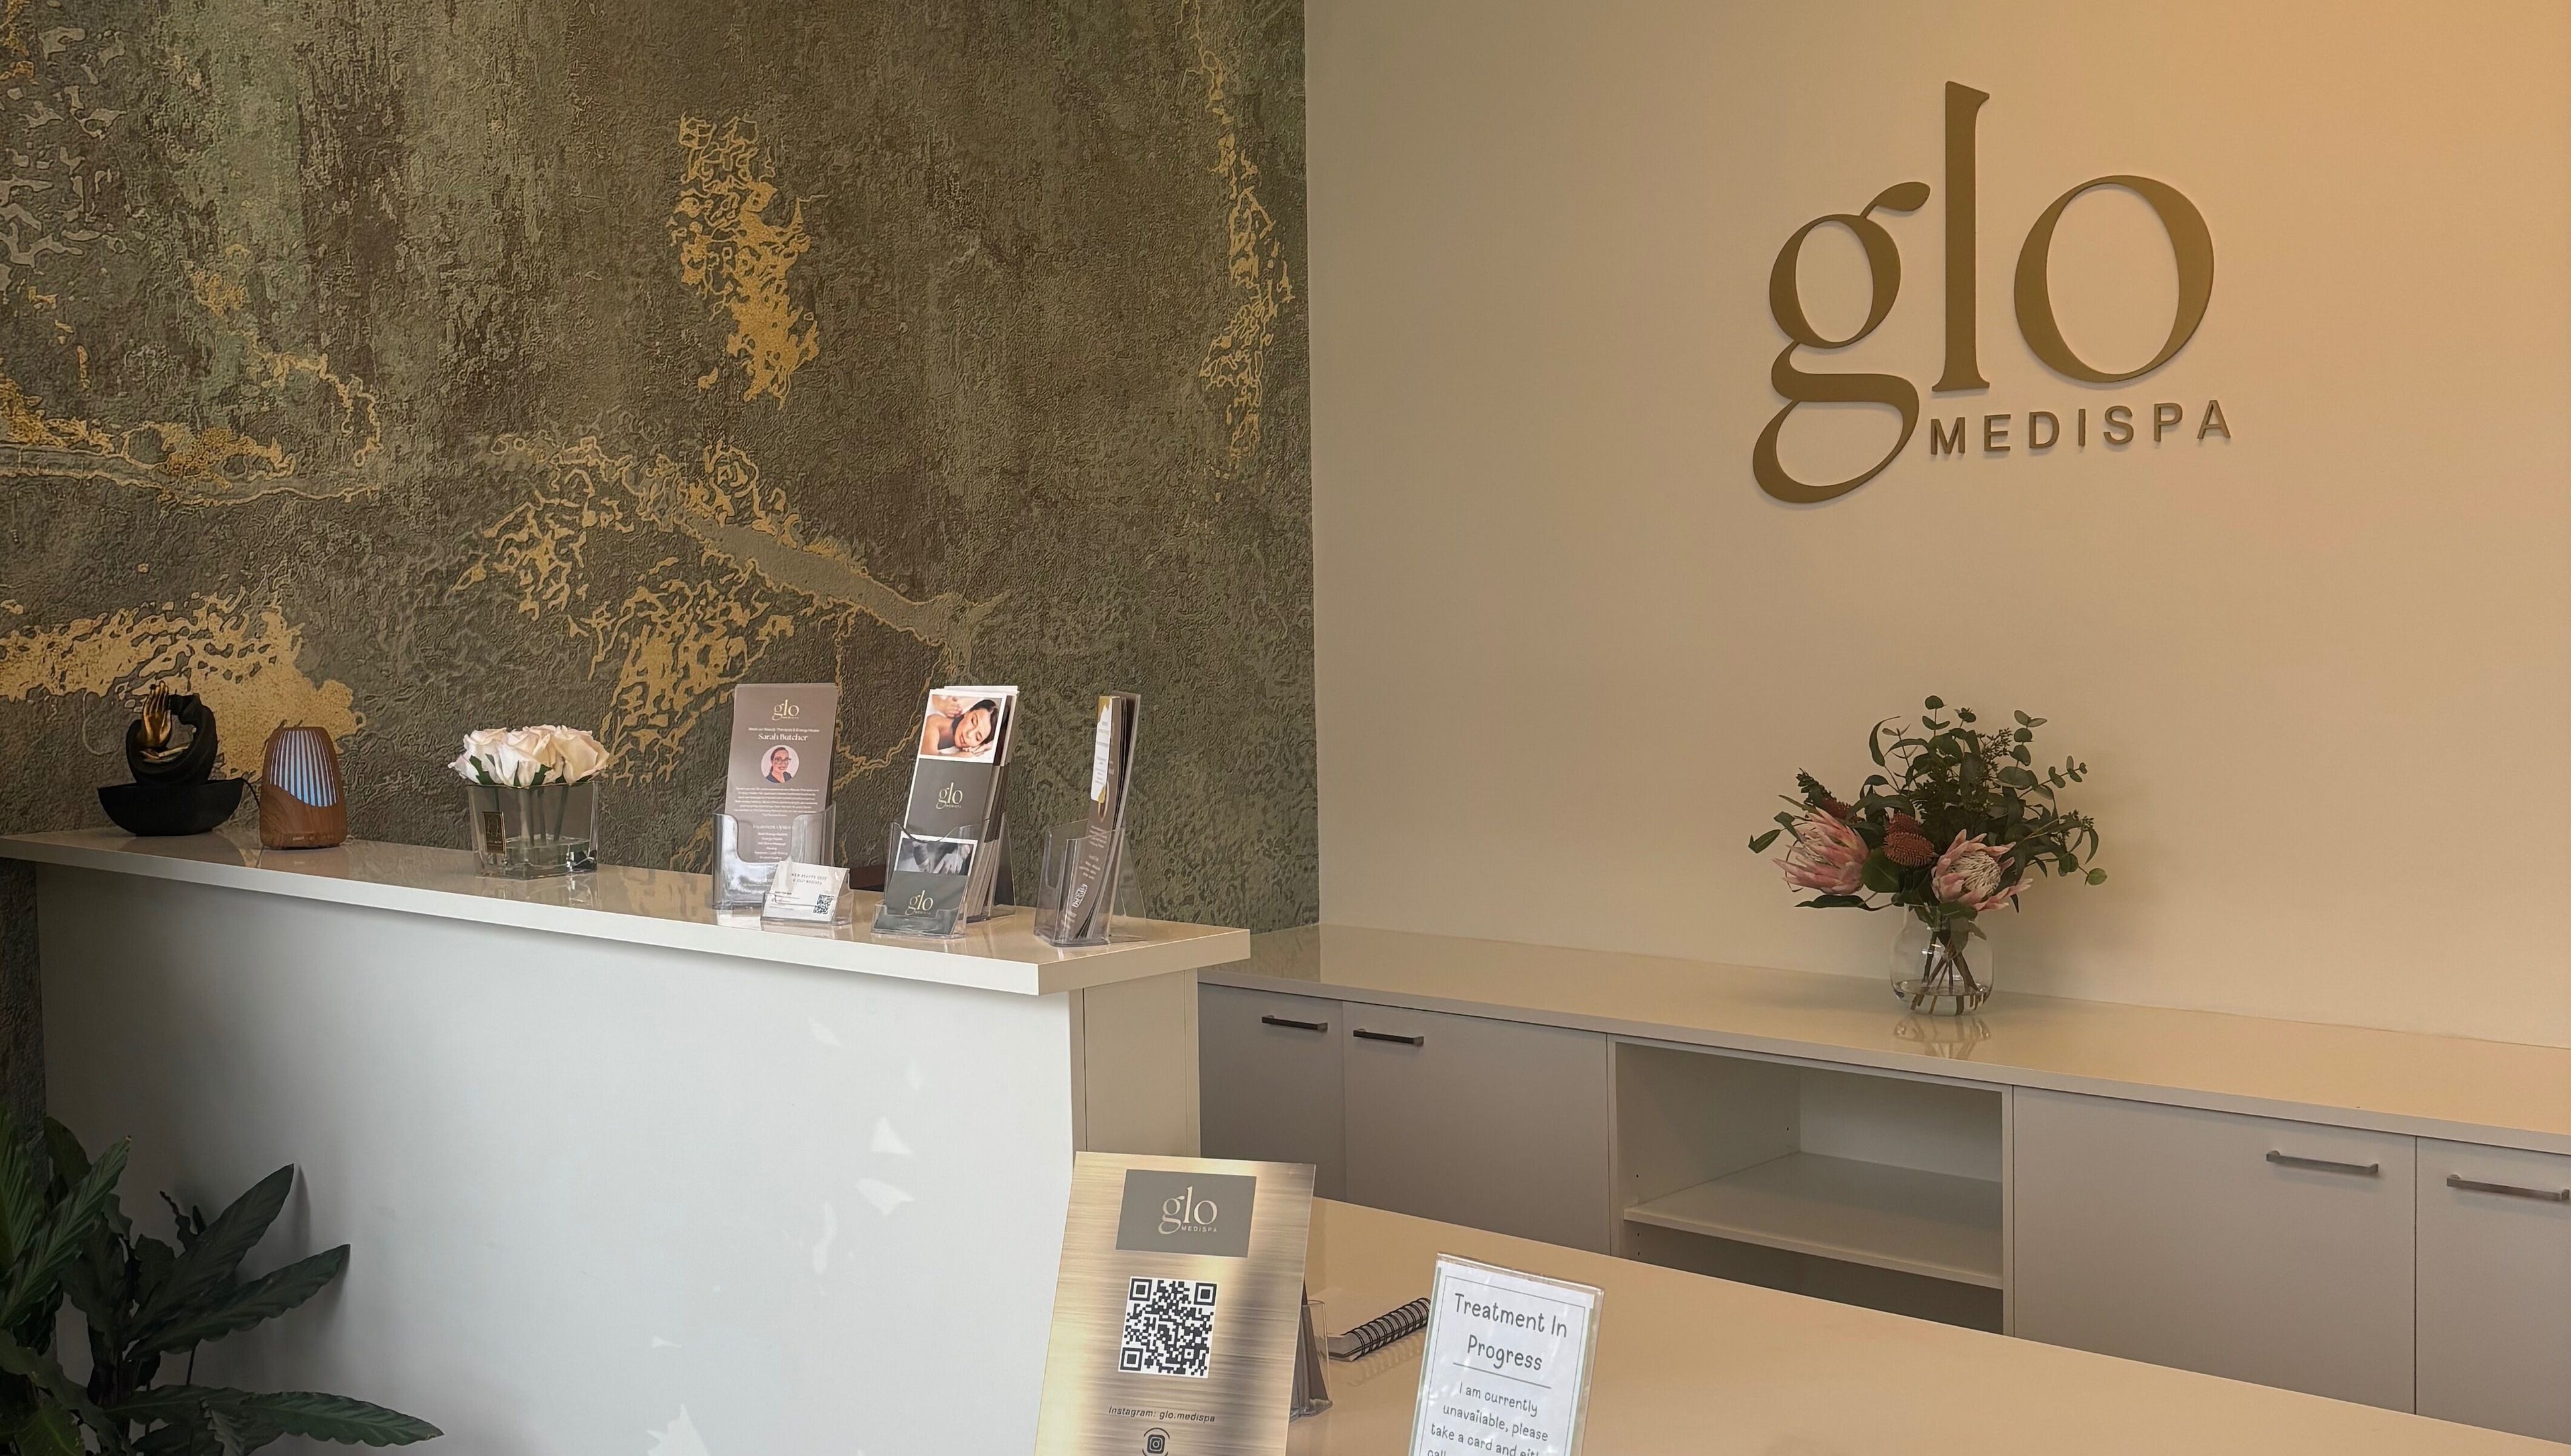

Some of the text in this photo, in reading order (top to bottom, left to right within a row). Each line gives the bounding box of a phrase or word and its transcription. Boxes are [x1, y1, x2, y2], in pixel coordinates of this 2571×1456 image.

[1752, 81, 2215, 503] glo
[1930, 399, 2231, 456] MEDISPA
[772, 699, 799, 721] glo
[936, 782, 963, 809] glo
[905, 890, 933, 915] glo
[1158, 1186, 1218, 1234] glo
[1454, 1293, 1567, 1338] Treatment In
[1467, 1334, 1542, 1370] Progress
[1109, 1405, 1215, 1424] Instagram: glo.medispa
[1459, 1381, 1538, 1418] I am currently
[1431, 1423, 1454, 1440] take
[1458, 1434, 1464, 1443] a
[1467, 1437, 1493, 1451] card
[1496, 1444, 1517, 1456] and
[1443, 1404, 1548, 1441] unavailable, please
